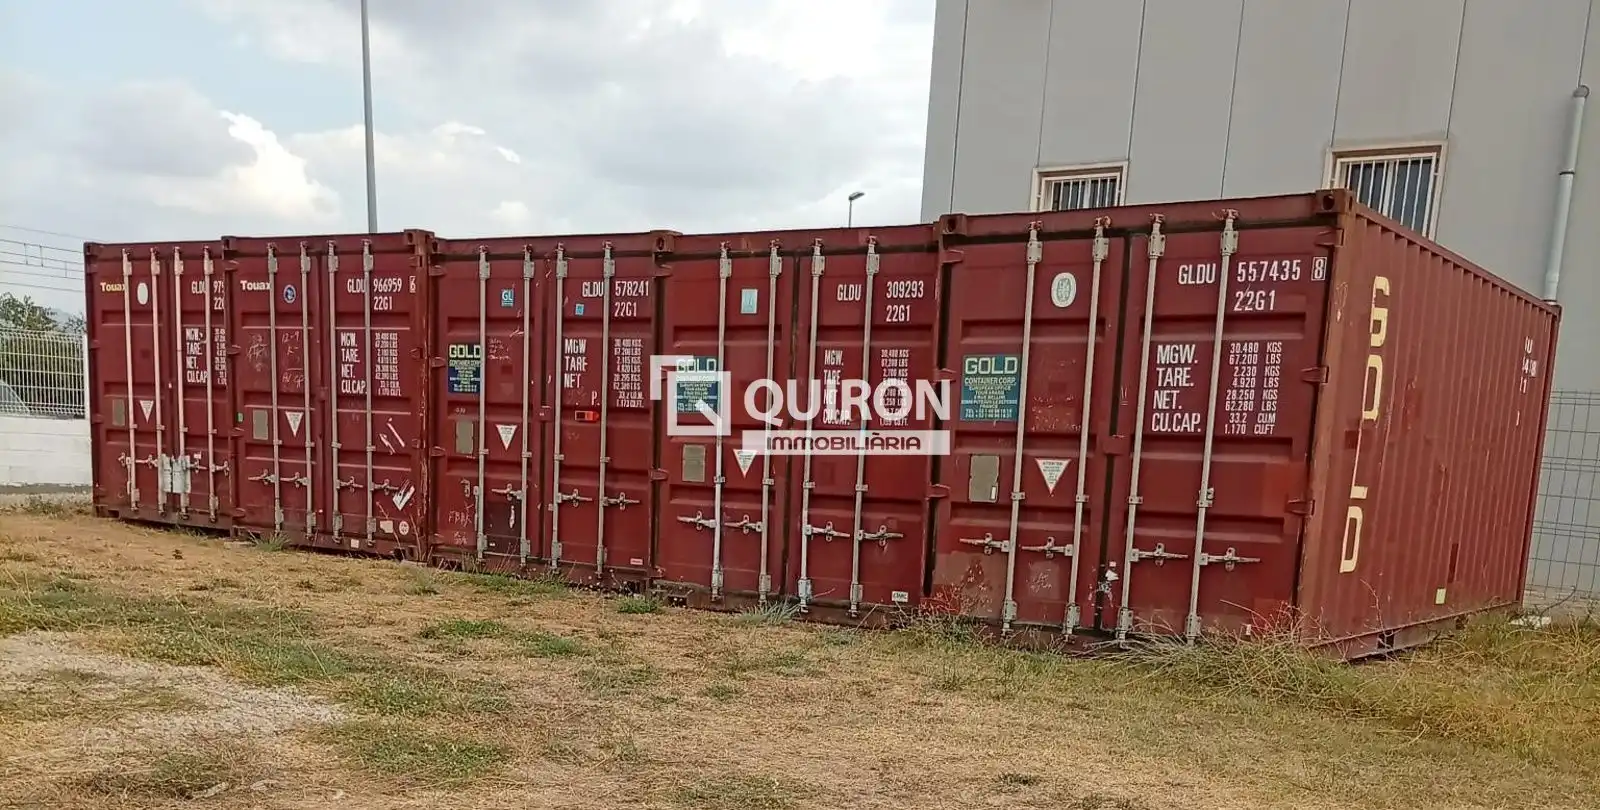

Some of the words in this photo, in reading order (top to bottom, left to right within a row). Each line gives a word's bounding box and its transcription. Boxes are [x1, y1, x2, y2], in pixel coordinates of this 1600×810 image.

[1178, 263, 1216, 285] GLDU
[1236, 259, 1301, 282] 557435
[1313, 258, 1325, 280] 8
[373, 278, 402, 293] 966959
[582, 281, 604, 297] GLDU
[615, 280, 649, 296] 578241
[837, 284, 861, 301] GLDU
[886, 280, 924, 298] 309293
[373, 296, 392, 311] 22G1
[1233, 290, 1276, 311] 22G1
[886, 304, 911, 322] 22G1
[1156, 344, 1198, 365] MGW.
[1230, 342, 1259, 354] 30.480
[1266, 341, 1282, 353] KGS
[824, 350, 844, 366] MGW.
[965, 357, 1018, 375] GOLD
[1229, 354, 1258, 365] 67.200
[1265, 353, 1281, 365] LBS
[1156, 367, 1194, 387] TARE.
[1233, 366, 1257, 377] 2.230
[1264, 365, 1281, 377] KGS
[1232, 377, 1256, 388] 4.920
[1263, 377, 1279, 388] LBS
[1153, 389, 1182, 410] NET.
[1226, 389, 1255, 400] 28.250
[1262, 389, 1278, 400] KGS
[1225, 400, 1254, 411] 62.280
[1261, 400, 1277, 411] LBS
[1151, 412, 1201, 433] CU.CAP.
[1229, 412, 1248, 423] 33.2
[1224, 424, 1247, 434] 1.170
